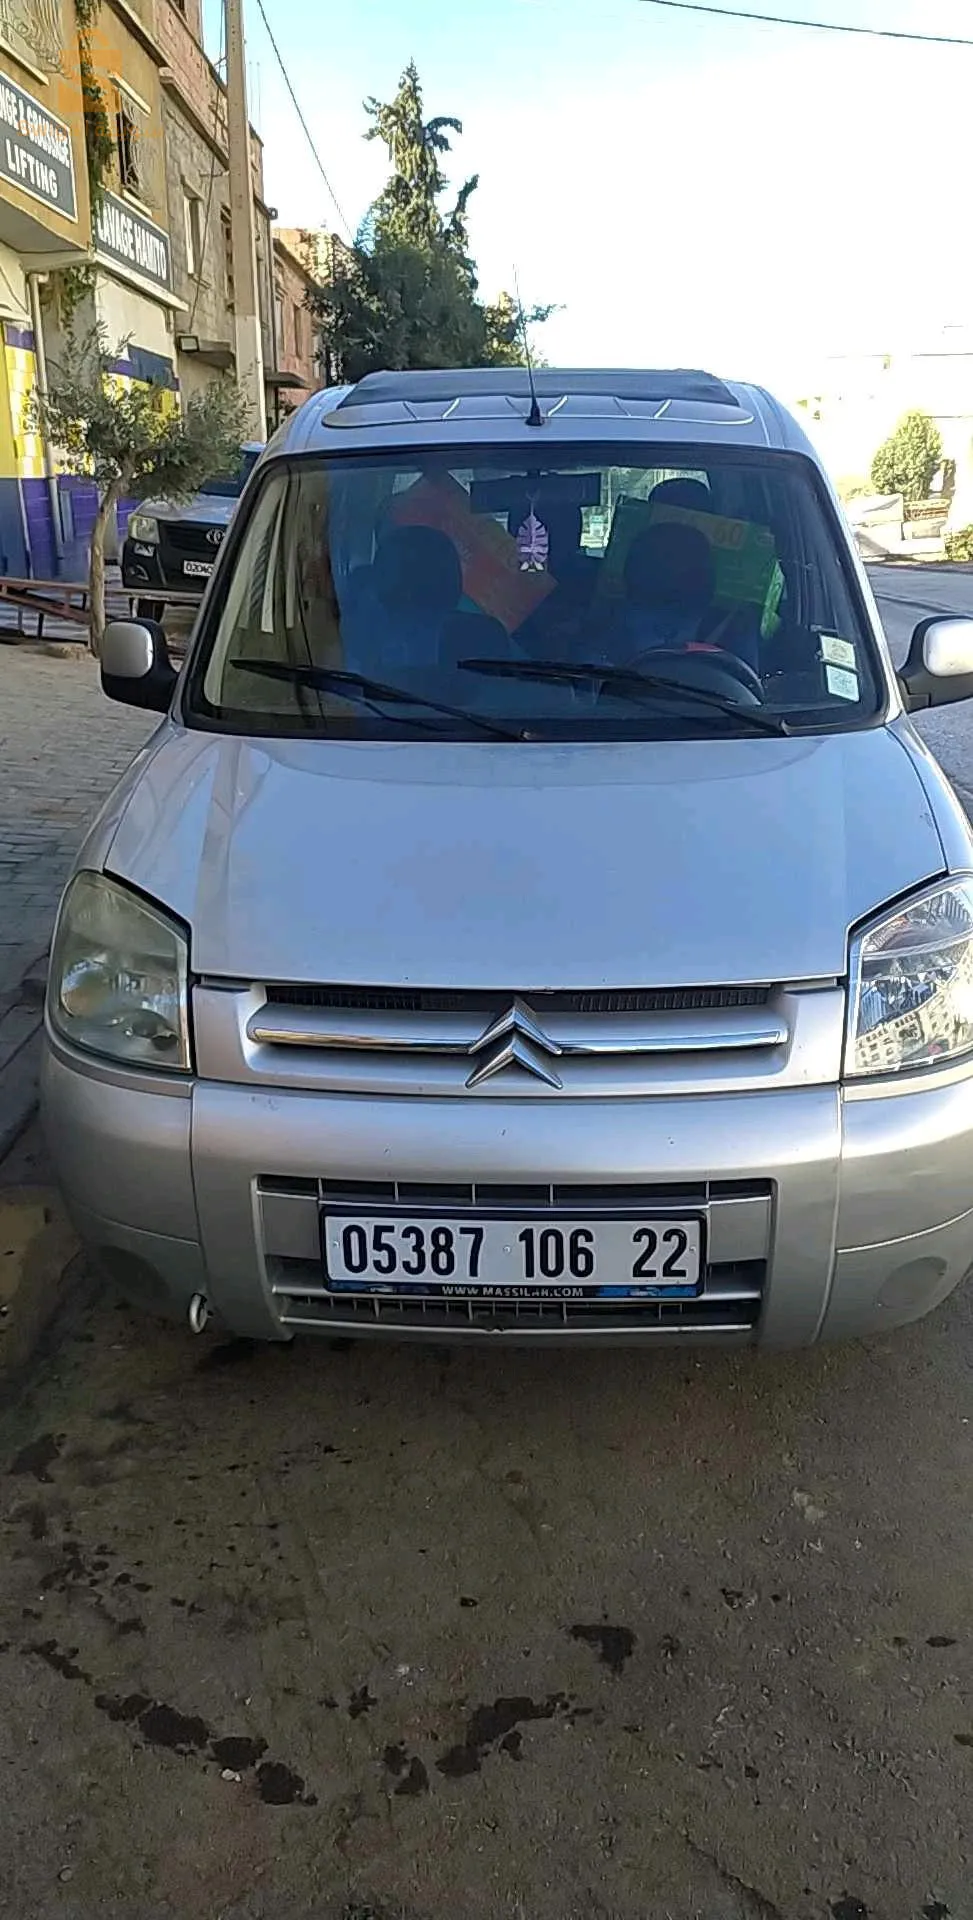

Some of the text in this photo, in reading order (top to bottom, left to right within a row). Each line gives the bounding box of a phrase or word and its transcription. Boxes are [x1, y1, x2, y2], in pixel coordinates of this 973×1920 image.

[5, 137, 59, 199] LIFTING
[341, 1223, 688, 1279] 05387 106 22
